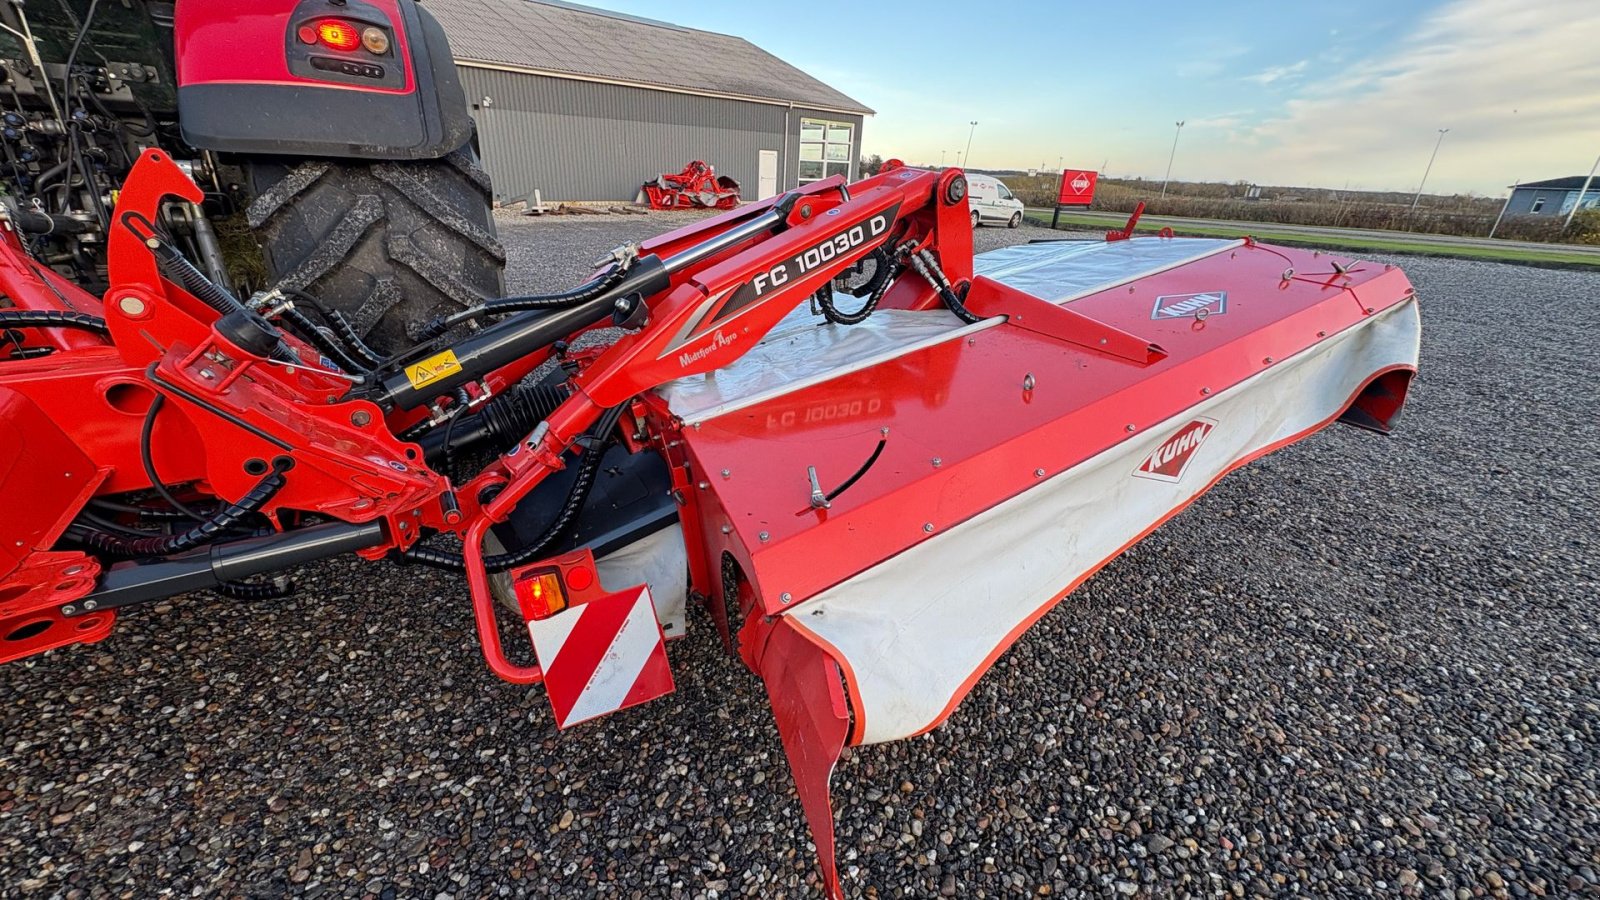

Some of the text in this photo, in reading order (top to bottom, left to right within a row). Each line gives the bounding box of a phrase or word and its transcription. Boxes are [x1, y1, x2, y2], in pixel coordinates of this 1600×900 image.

[753, 215, 887, 295] FC 10030 D
[1157, 294, 1221, 317] KUHN
[679, 330, 738, 368] Midtfjord Agro
[1148, 423, 1207, 472] KUHN
